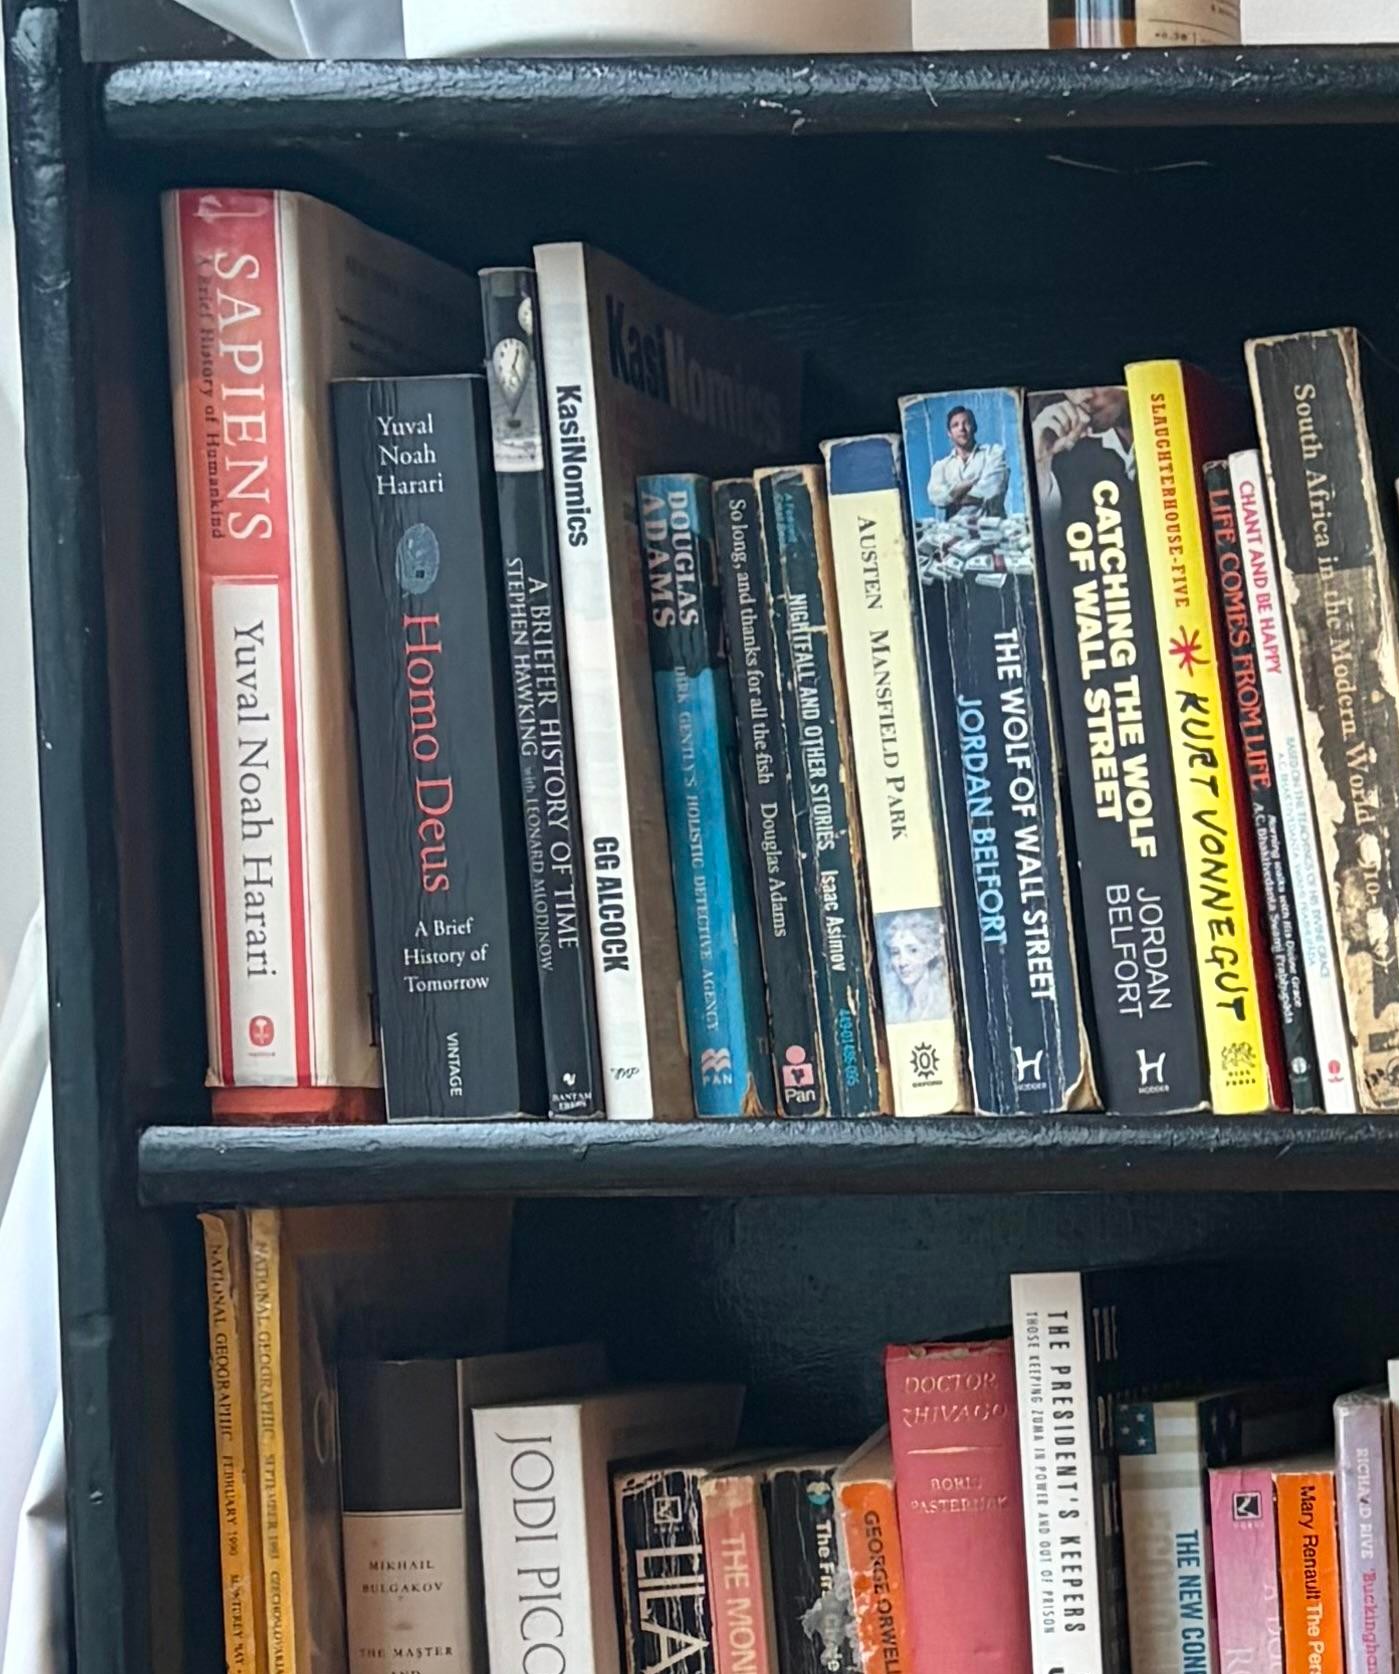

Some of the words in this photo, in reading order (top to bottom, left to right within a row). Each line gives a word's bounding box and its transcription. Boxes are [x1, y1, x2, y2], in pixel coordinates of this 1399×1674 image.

[214, 253, 272, 540] SAPIENS
[377, 416, 434, 437] Yuval
[377, 474, 444, 495] Harari
[378, 446, 437, 466] Noah
[555, 385, 589, 548] KasiNomics
[1151, 393, 1189, 608] SLAUGHTERHOUSE-FIVE
[506, 558, 529, 645] STEPHEN
[643, 498, 676, 629] ADAMS
[667, 491, 699, 626] DOUGLAS
[857, 516, 884, 611] AUSTEN
[403, 612, 442, 764] Homo
[512, 653, 539, 757] HAWKING
[870, 629, 899, 769] MANSFIELD
[957, 695, 995, 817] JORDAN
[1175, 690, 1218, 799] KURT
[416, 777, 453, 894] Deus
[886, 776, 908, 841] PARK
[973, 827, 1007, 946] BELFORT
[1193, 810, 1248, 1021] VONNEGUT
[215, 1335, 232, 1441] GEOGRAPHIC
[1050, 1365, 1080, 1520] PRESIDENT'S
[495, 1432, 558, 1543] JODI
[362, 1582, 443, 1594] BULGAKOV
[864, 1511, 889, 1596] GEORGE
[1061, 1536, 1086, 1633] KEEPERS
